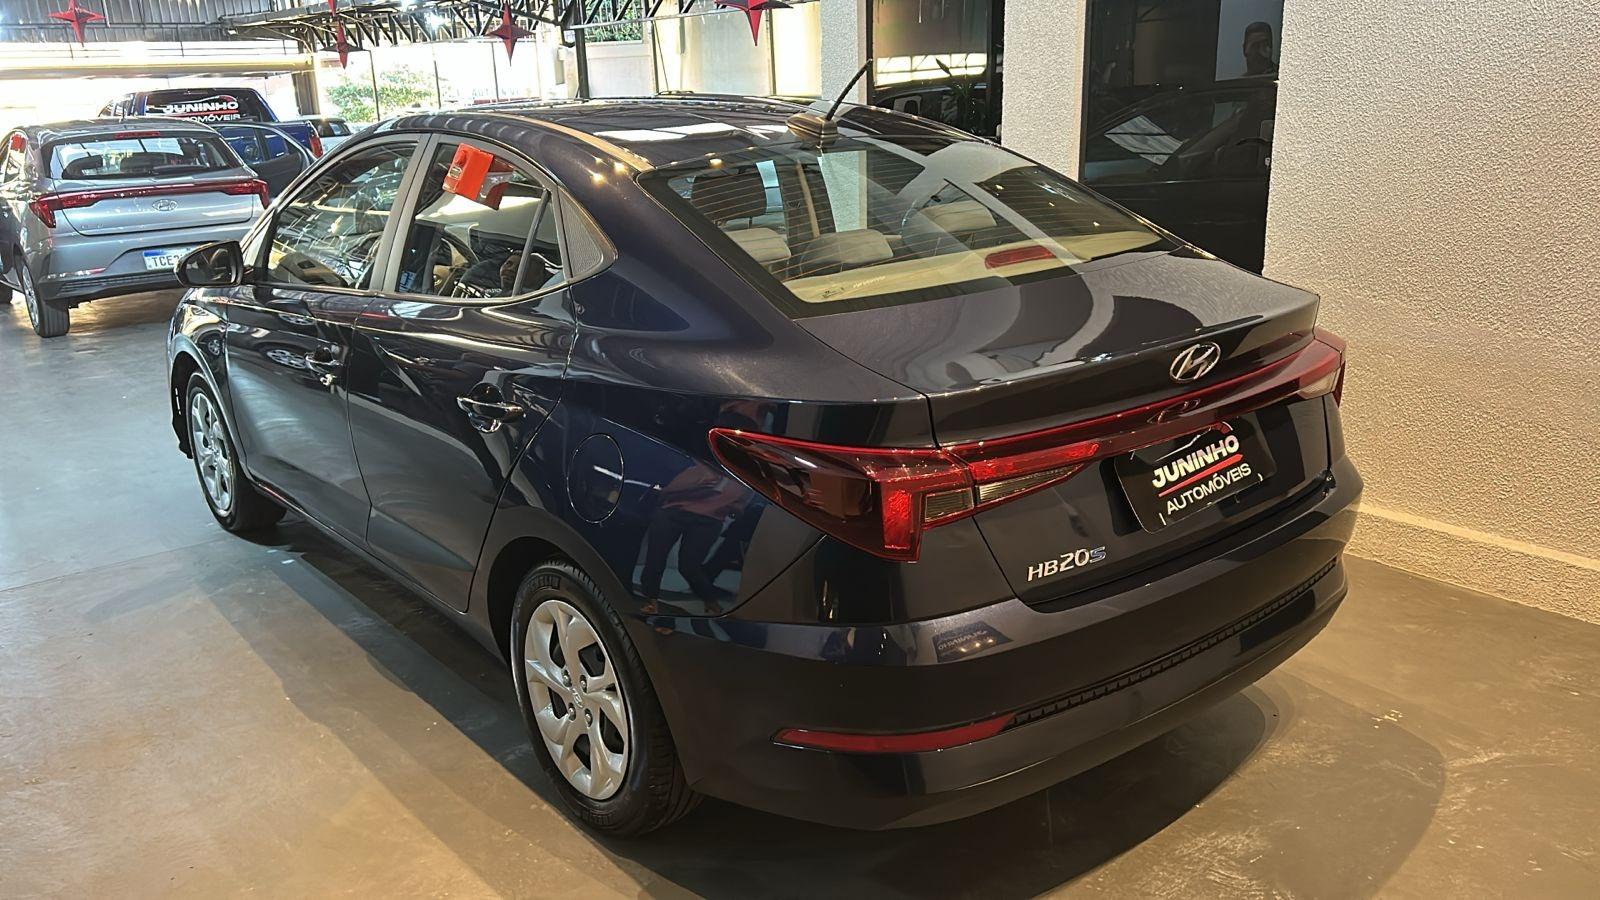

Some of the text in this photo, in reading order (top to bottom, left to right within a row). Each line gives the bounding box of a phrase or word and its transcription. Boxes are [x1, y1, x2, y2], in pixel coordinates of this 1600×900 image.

[163, 102, 239, 113] JUNINHO
[1152, 435, 1240, 488] JUNINHO
[1166, 463, 1252, 515] AUTOMÓVEIS
[1027, 546, 1107, 582] HB20S
